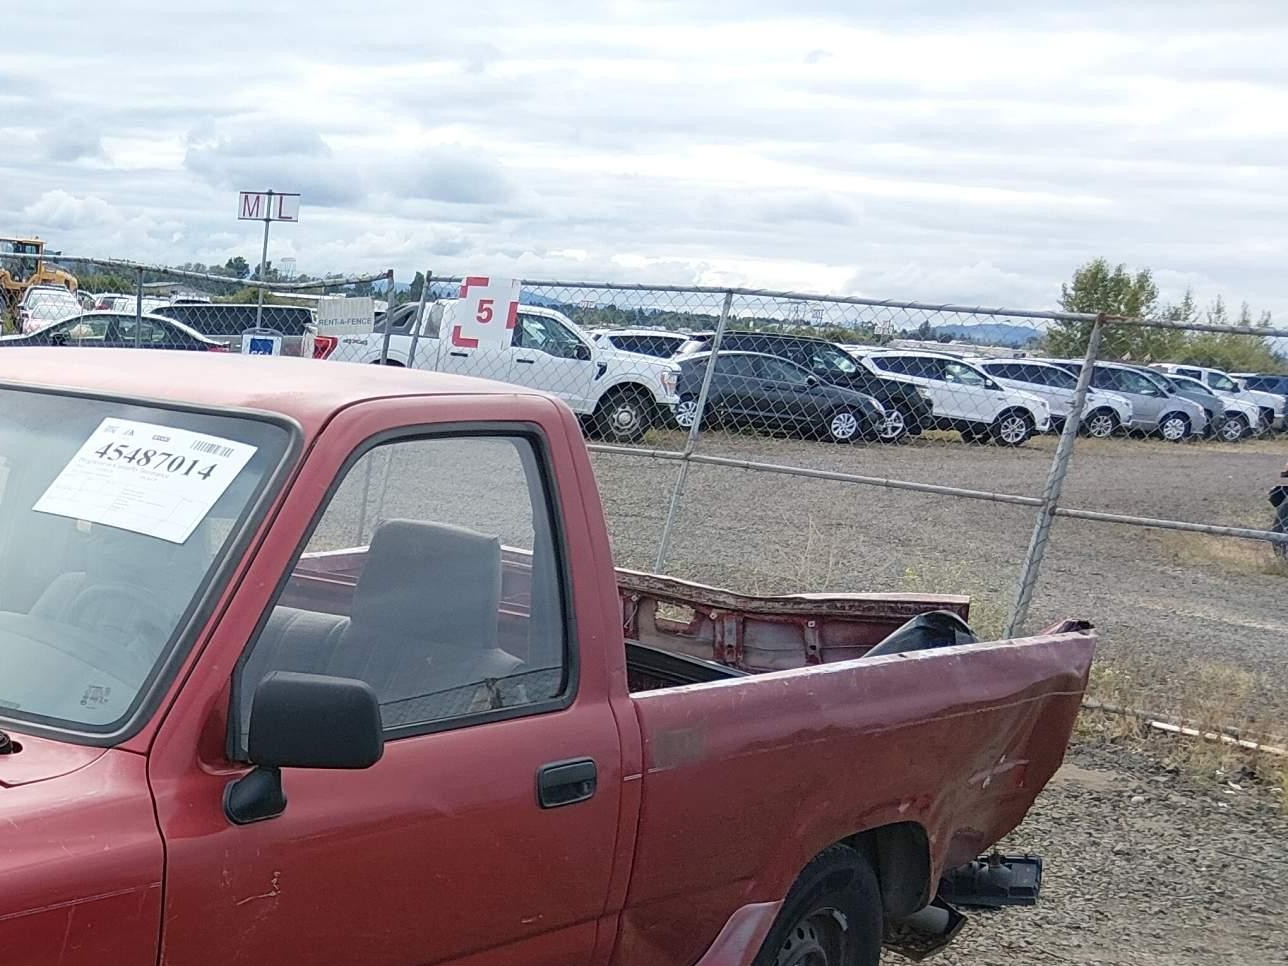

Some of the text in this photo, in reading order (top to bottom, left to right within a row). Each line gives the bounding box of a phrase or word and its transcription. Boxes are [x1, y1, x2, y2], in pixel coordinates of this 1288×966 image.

[242, 195, 293, 220] M L
[476, 299, 493, 324] 5
[95, 441, 218, 481] 45487014
